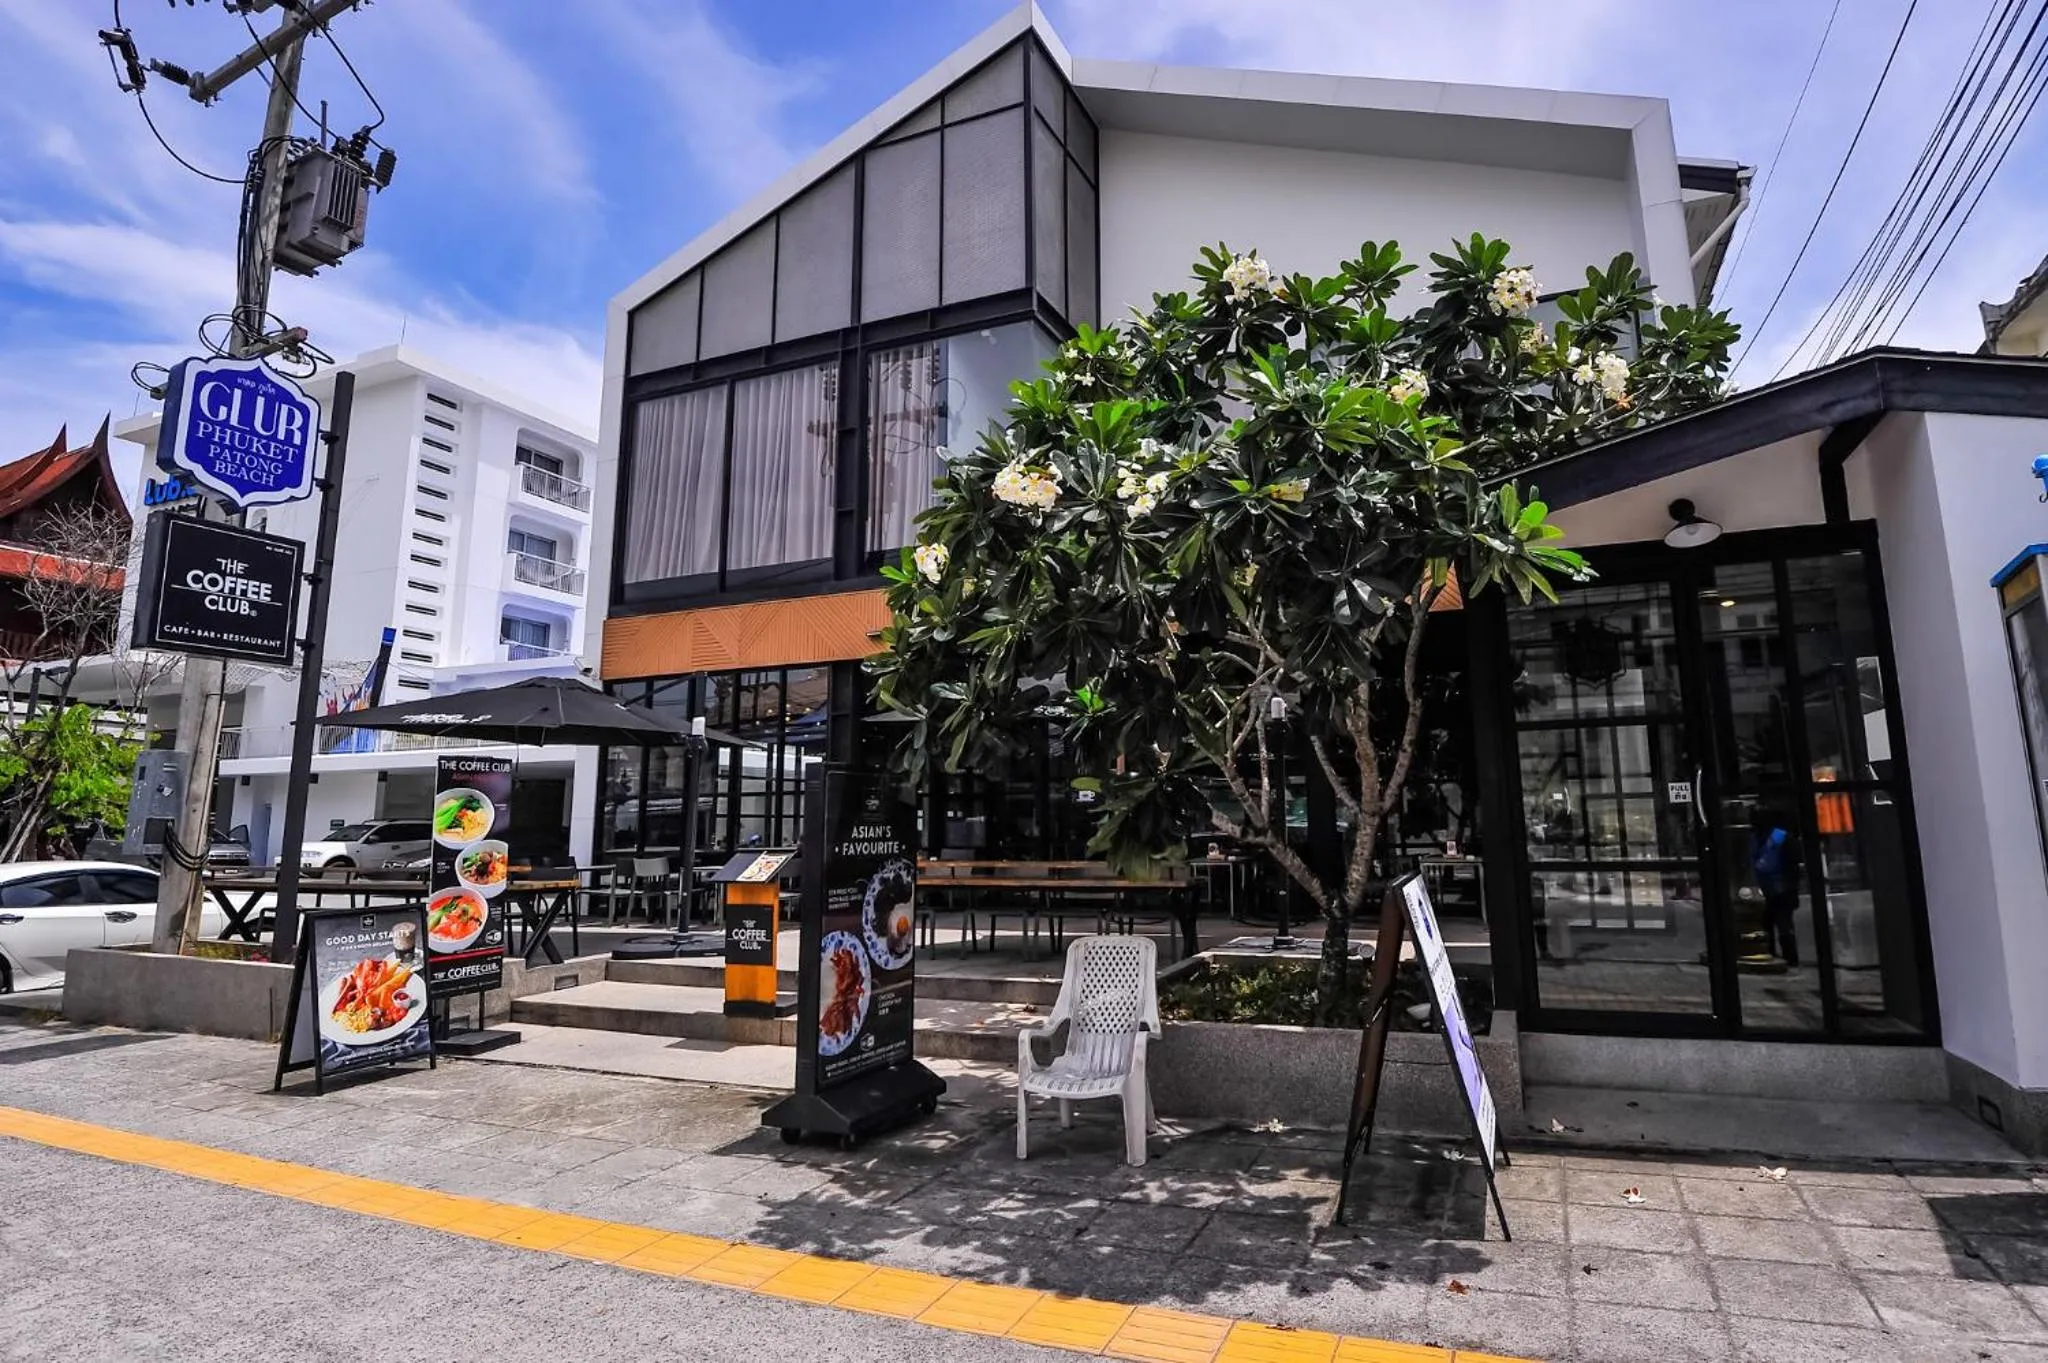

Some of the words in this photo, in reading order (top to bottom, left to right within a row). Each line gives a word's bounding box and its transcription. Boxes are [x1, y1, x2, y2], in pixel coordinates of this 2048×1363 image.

[200, 381, 304, 446] GLUR
[195, 420, 299, 463] PHUKET
[208, 444, 283, 475] PATONG
[213, 460, 274, 487] BEACH
[216, 558, 250, 574] THE
[186, 569, 273, 602] COFFEE
[197, 629, 215, 638] BAR
[223, 633, 282, 648] RESTAURANT
[441, 760, 457, 770] THE
[459, 761, 490, 771] COFFEE
[492, 763, 511, 772] CLUB
[851, 826, 892, 838] ASIAN'S
[842, 841, 900, 855] FAVOURITE
[325, 935, 355, 946] GOOD
[357, 932, 377, 942] DAY
[732, 929, 767, 940] COFFEE
[447, 964, 480, 979] COFFEE
